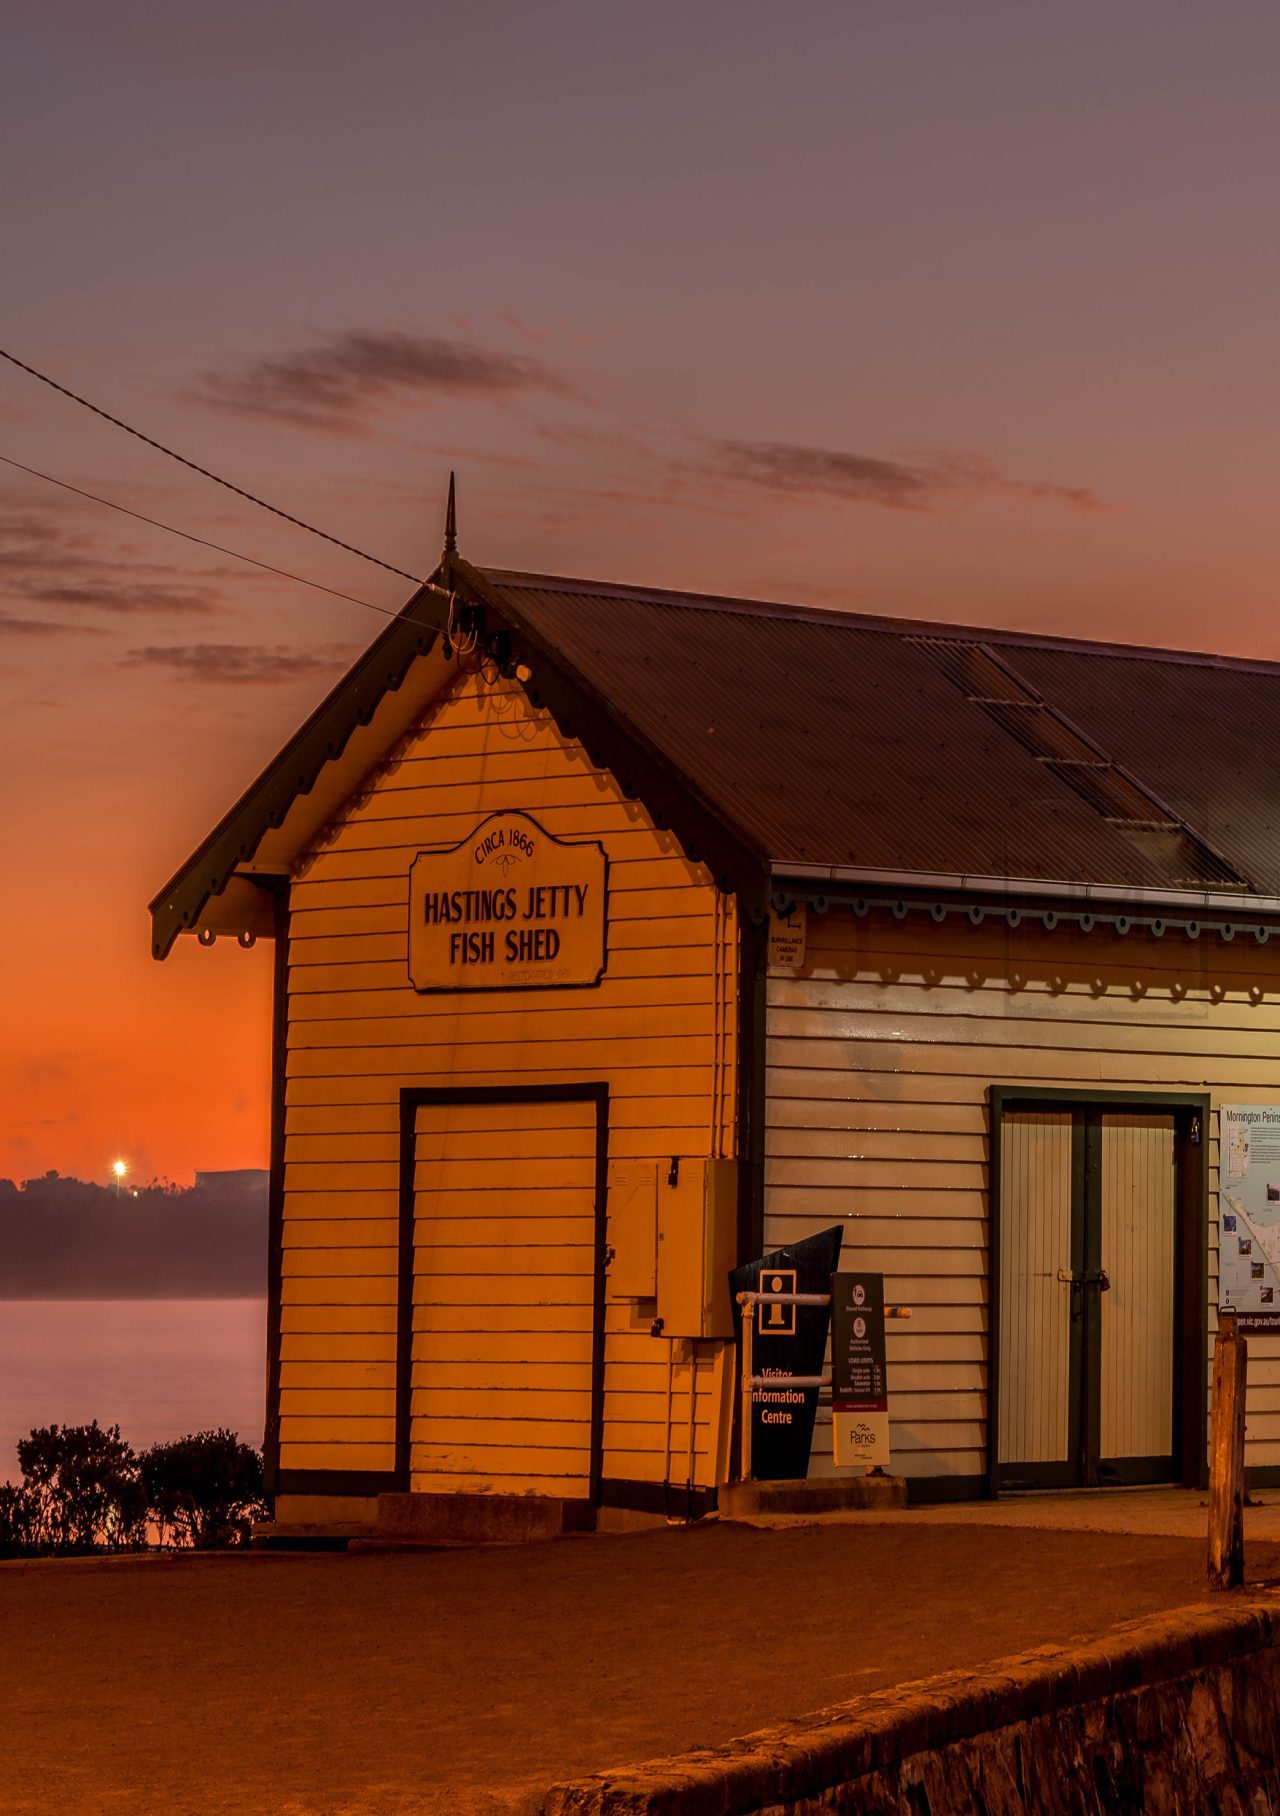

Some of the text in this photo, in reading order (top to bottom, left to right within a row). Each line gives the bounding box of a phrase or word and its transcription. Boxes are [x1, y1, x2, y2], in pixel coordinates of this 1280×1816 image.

[474, 828, 535, 865] CIRCA 1866
[424, 883, 589, 925] HASTINGS JETTY
[449, 928, 560, 965] FISH SHED
[1226, 1110, 1261, 1125] Mornington
[761, 1367, 793, 1378] Visitor
[752, 1389, 805, 1404] nformation
[761, 1409, 792, 1424] Centre
[850, 1430, 876, 1445] Parks
